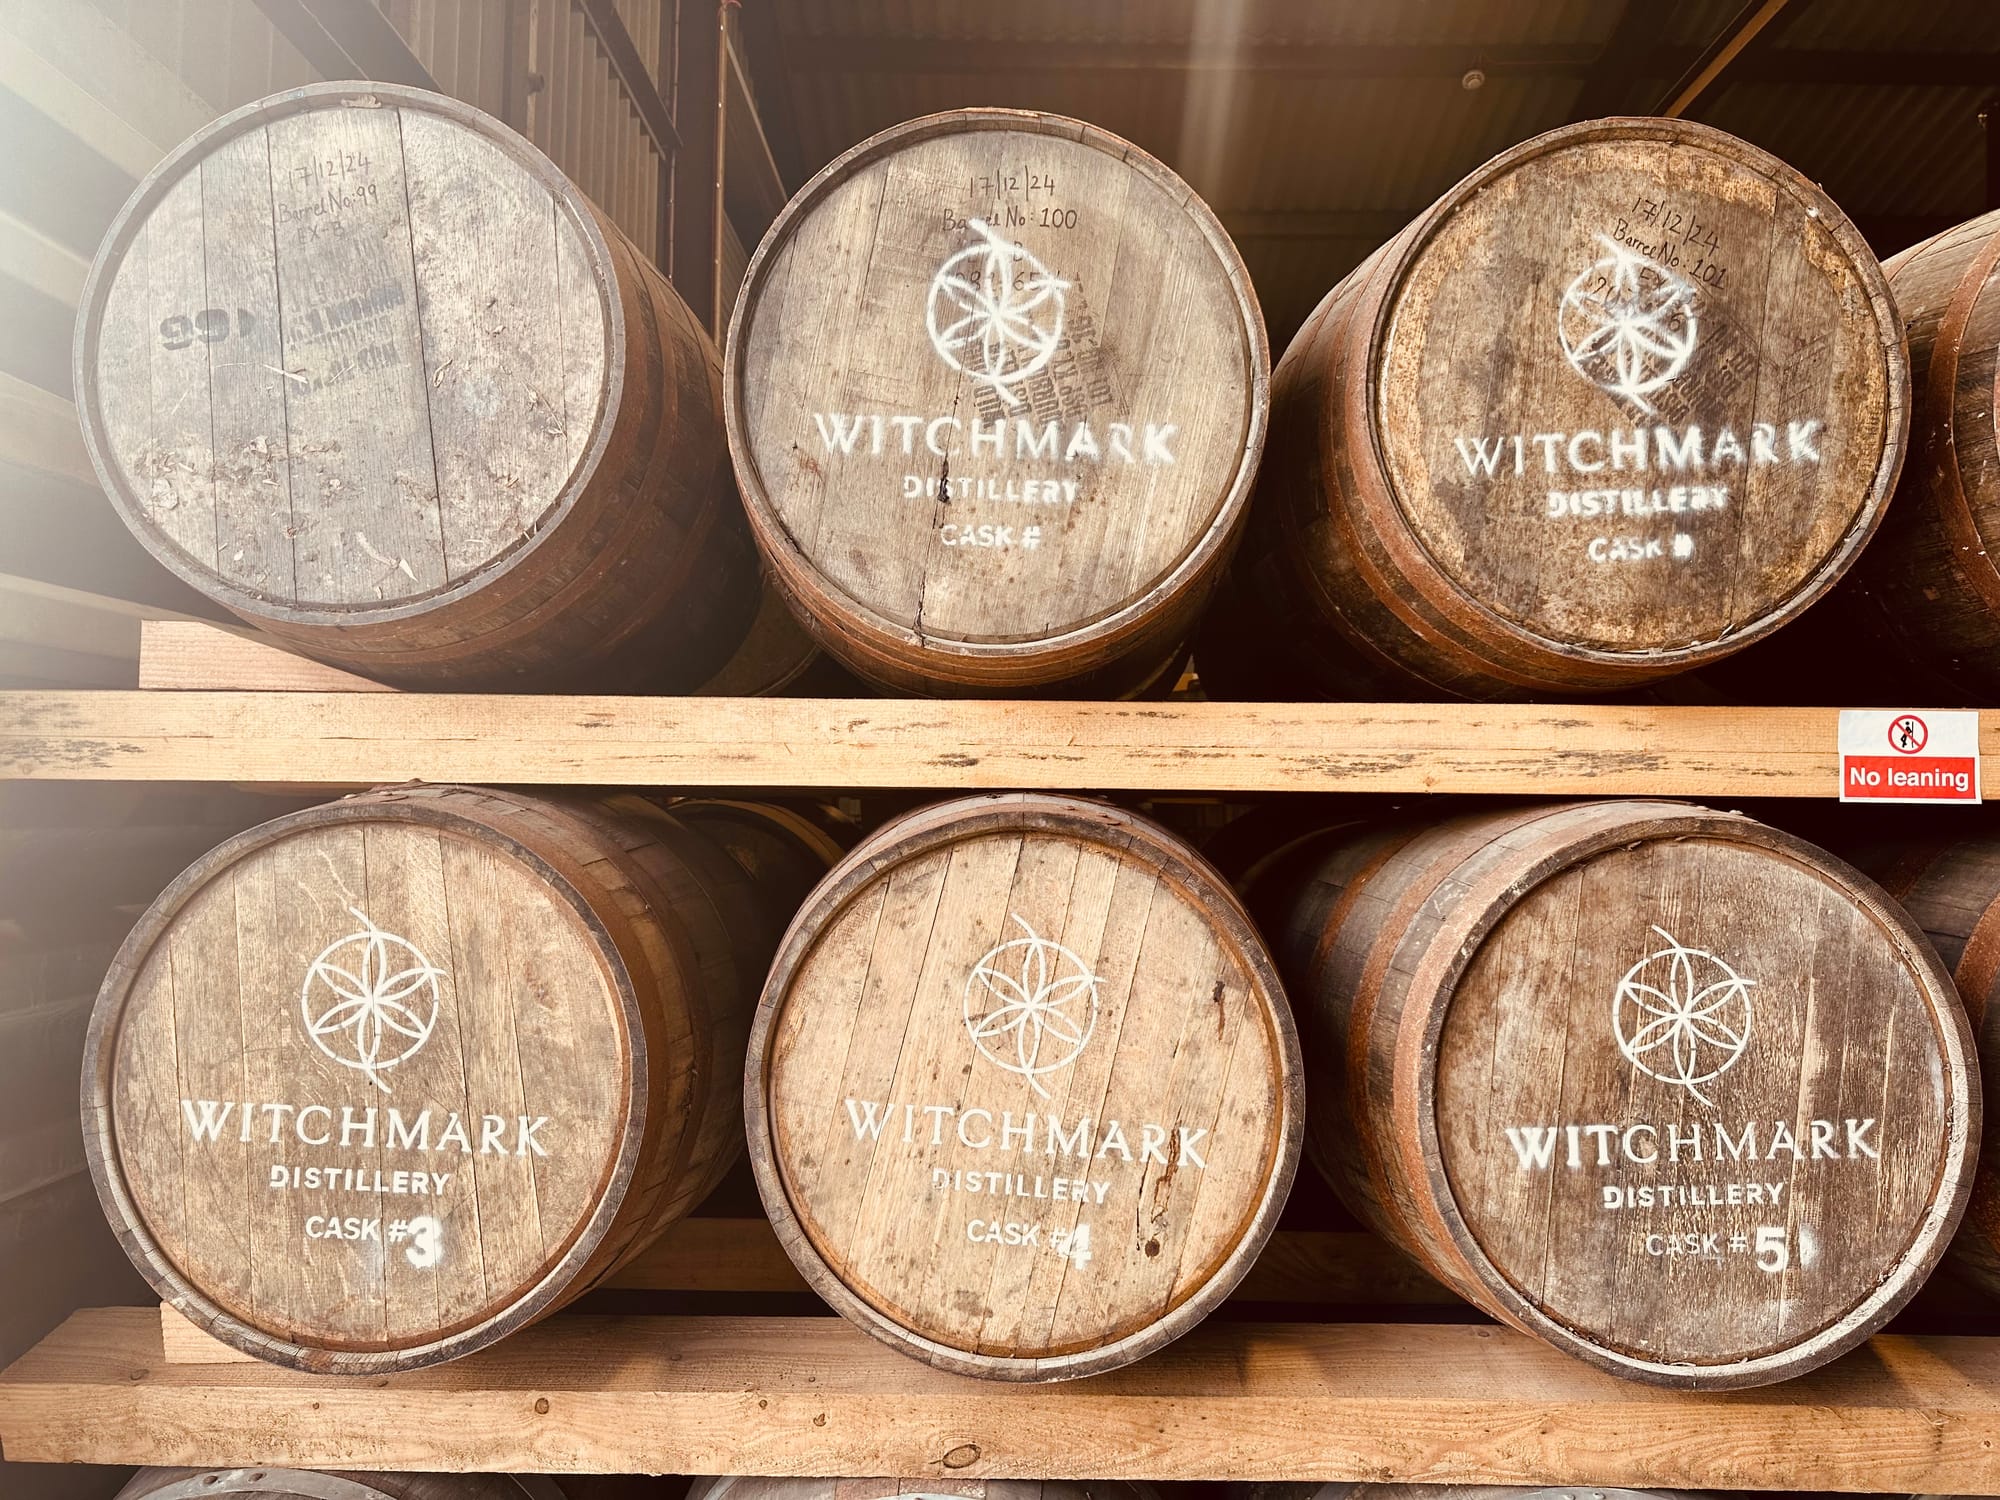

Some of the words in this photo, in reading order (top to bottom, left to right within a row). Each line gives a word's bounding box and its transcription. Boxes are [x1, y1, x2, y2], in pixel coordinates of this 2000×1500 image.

[288, 148, 372, 190] 17/12/24
[969, 164, 1056, 203] 17/12/24
[942, 207, 1002, 232] Bael
[1039, 206, 1079, 230] 100
[1631, 197, 1720, 257] 17/12/24
[1688, 258, 1727, 290] 101
[813, 412, 1180, 465] WITCHMARK
[1454, 418, 1822, 477] WITCHMARK
[903, 475, 1081, 504] DISTILLERY
[1547, 486, 1729, 518] DISTILLERY
[940, 523, 1012, 548] CASK
[1587, 538, 1663, 564] CASK
[1850, 767, 1881, 786] No
[1887, 768, 1969, 792] leaning
[181, 1099, 550, 1157] WITCHMARK
[844, 1098, 1209, 1170] WITCHMARK
[1506, 1117, 1881, 1171] WITCHMARK
[269, 1164, 450, 1196] DISTILLERY
[931, 1167, 1111, 1205] DISTILLERY
[1602, 1183, 1785, 1210] DISTILLERY
[305, 1215, 381, 1242] CASK
[967, 1218, 1040, 1248] CASK
[1645, 1231, 1721, 1257] CASK
